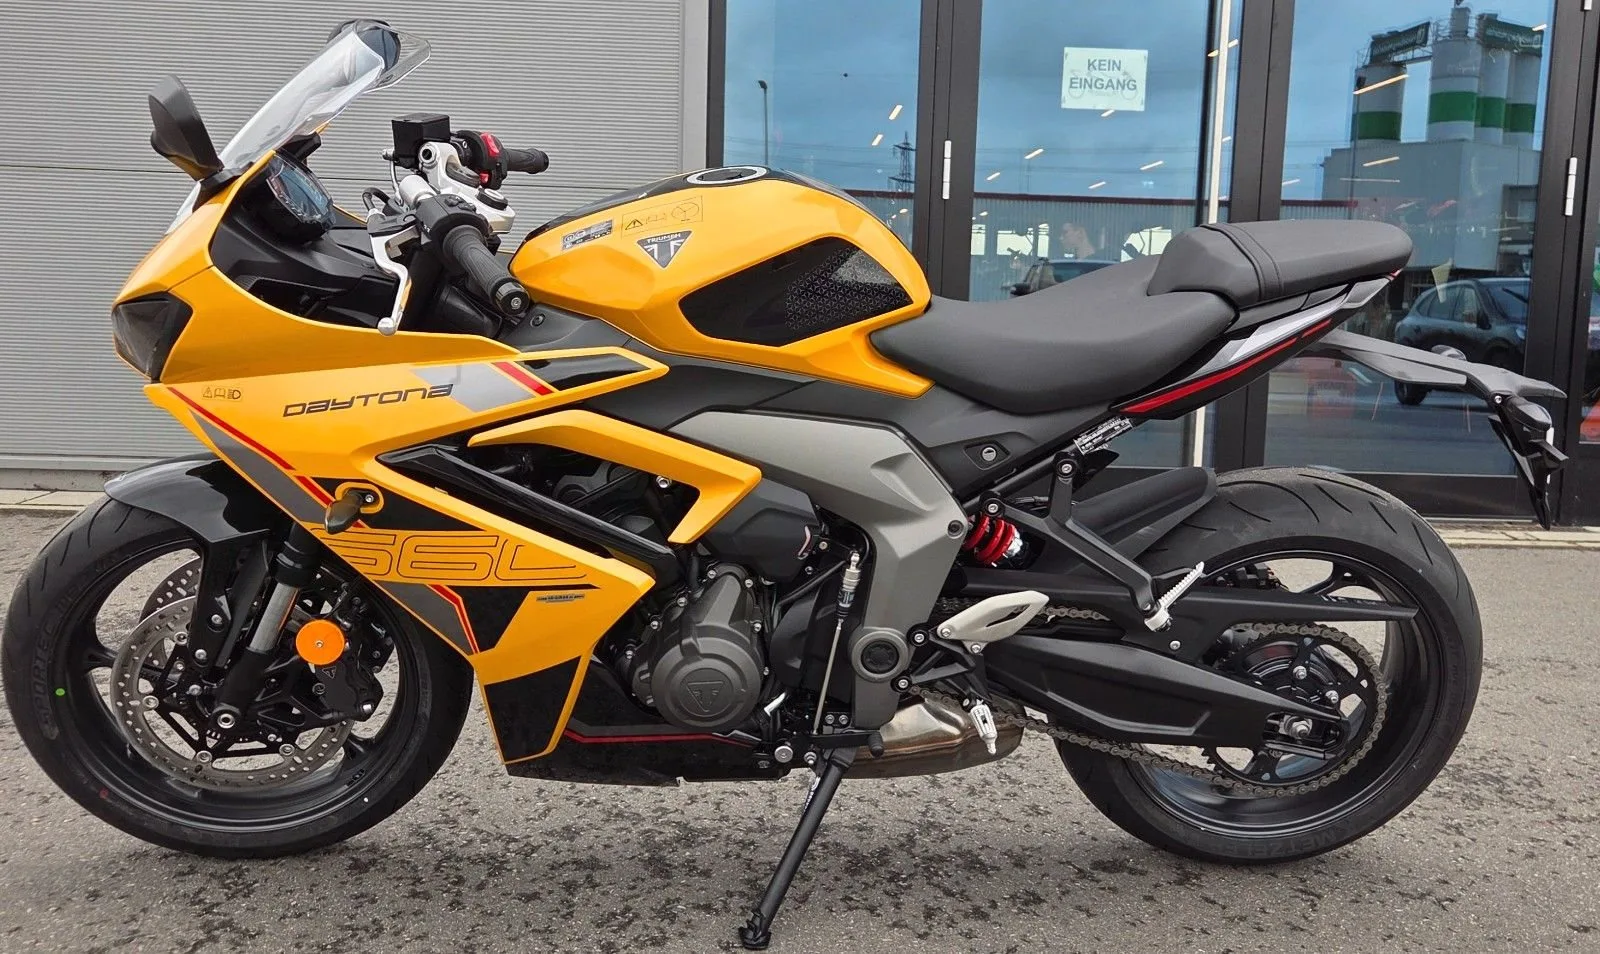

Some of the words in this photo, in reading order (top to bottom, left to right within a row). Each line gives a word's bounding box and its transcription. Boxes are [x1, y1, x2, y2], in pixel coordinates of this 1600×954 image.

[1087, 58, 1122, 72] KEIN
[1069, 77, 1137, 91] EINGANG
[647, 232, 681, 243] TRIUMPH
